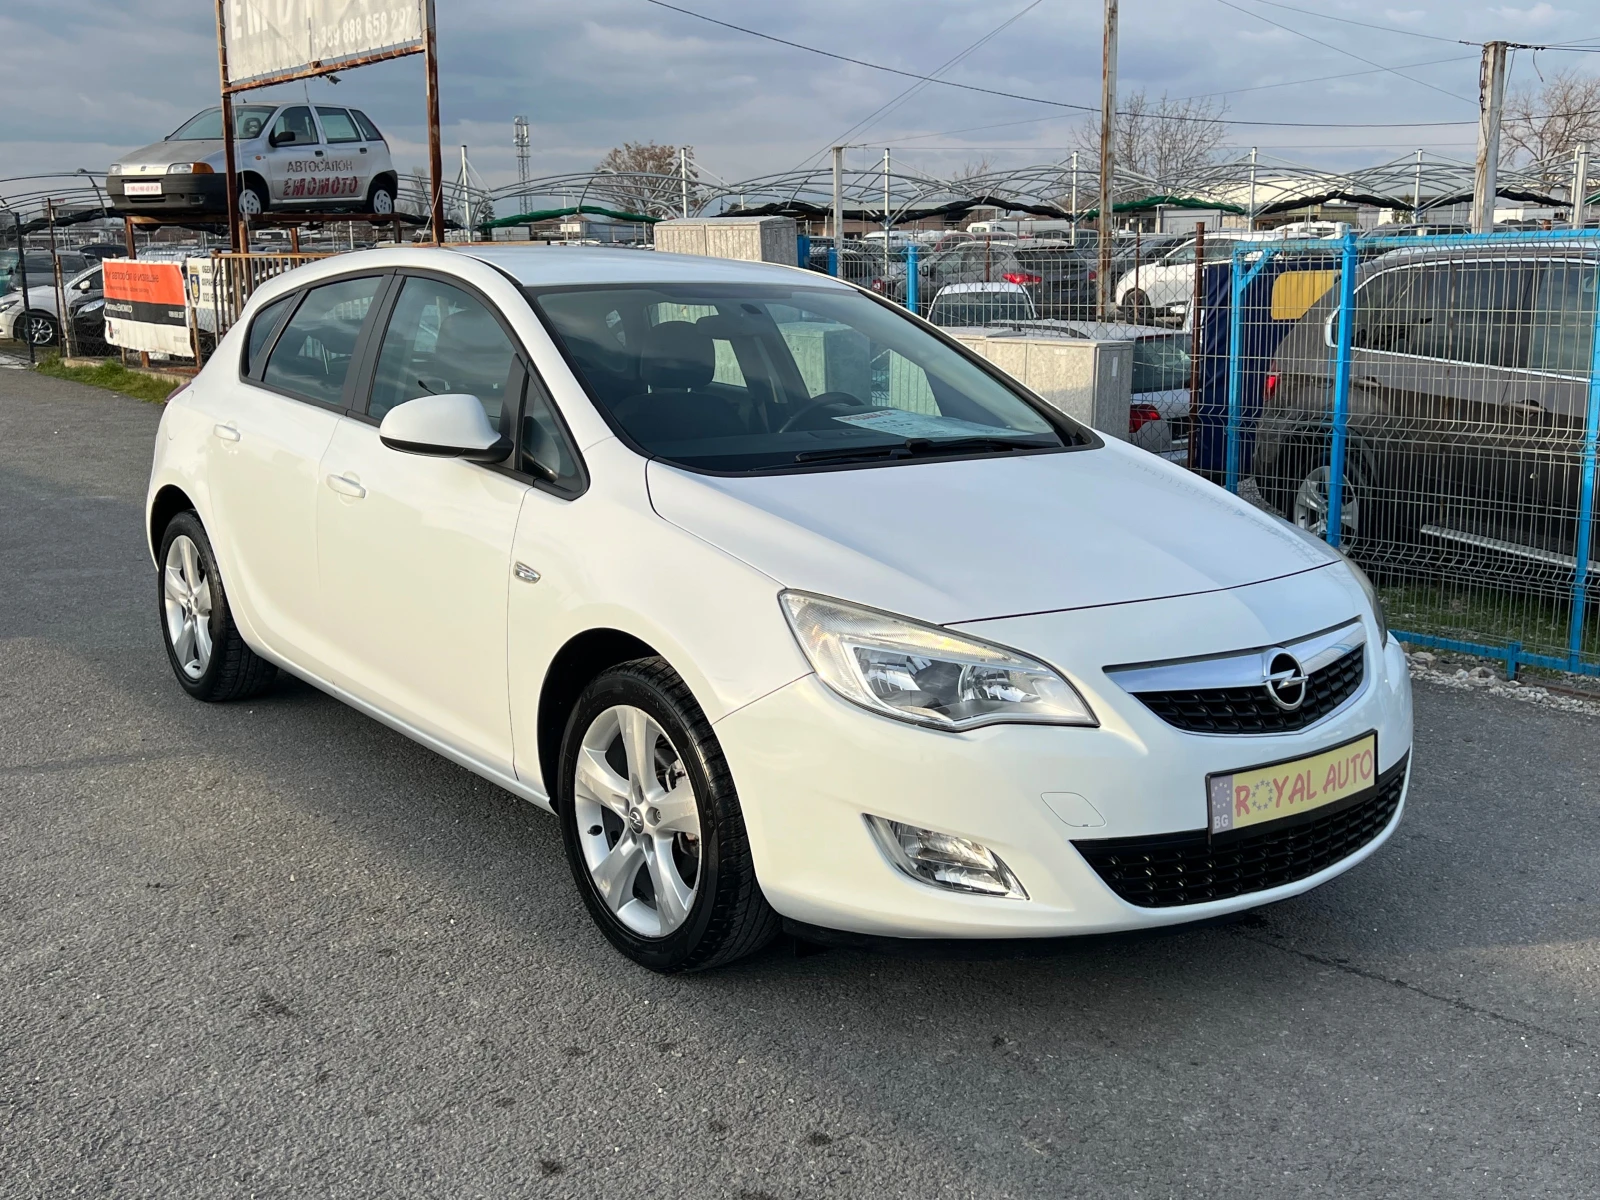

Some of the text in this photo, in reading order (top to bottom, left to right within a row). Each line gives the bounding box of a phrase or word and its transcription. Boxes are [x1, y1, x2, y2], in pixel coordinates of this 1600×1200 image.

[314, 25, 340, 49] +359
[343, 16, 362, 43] 888
[365, 11, 388, 39] 658
[391, 5, 412, 33] 297
[286, 159, 353, 173] АВТОСАЛОН
[1234, 749, 1373, 818] ROYAL AUTO
[1213, 814, 1229, 830] BG
